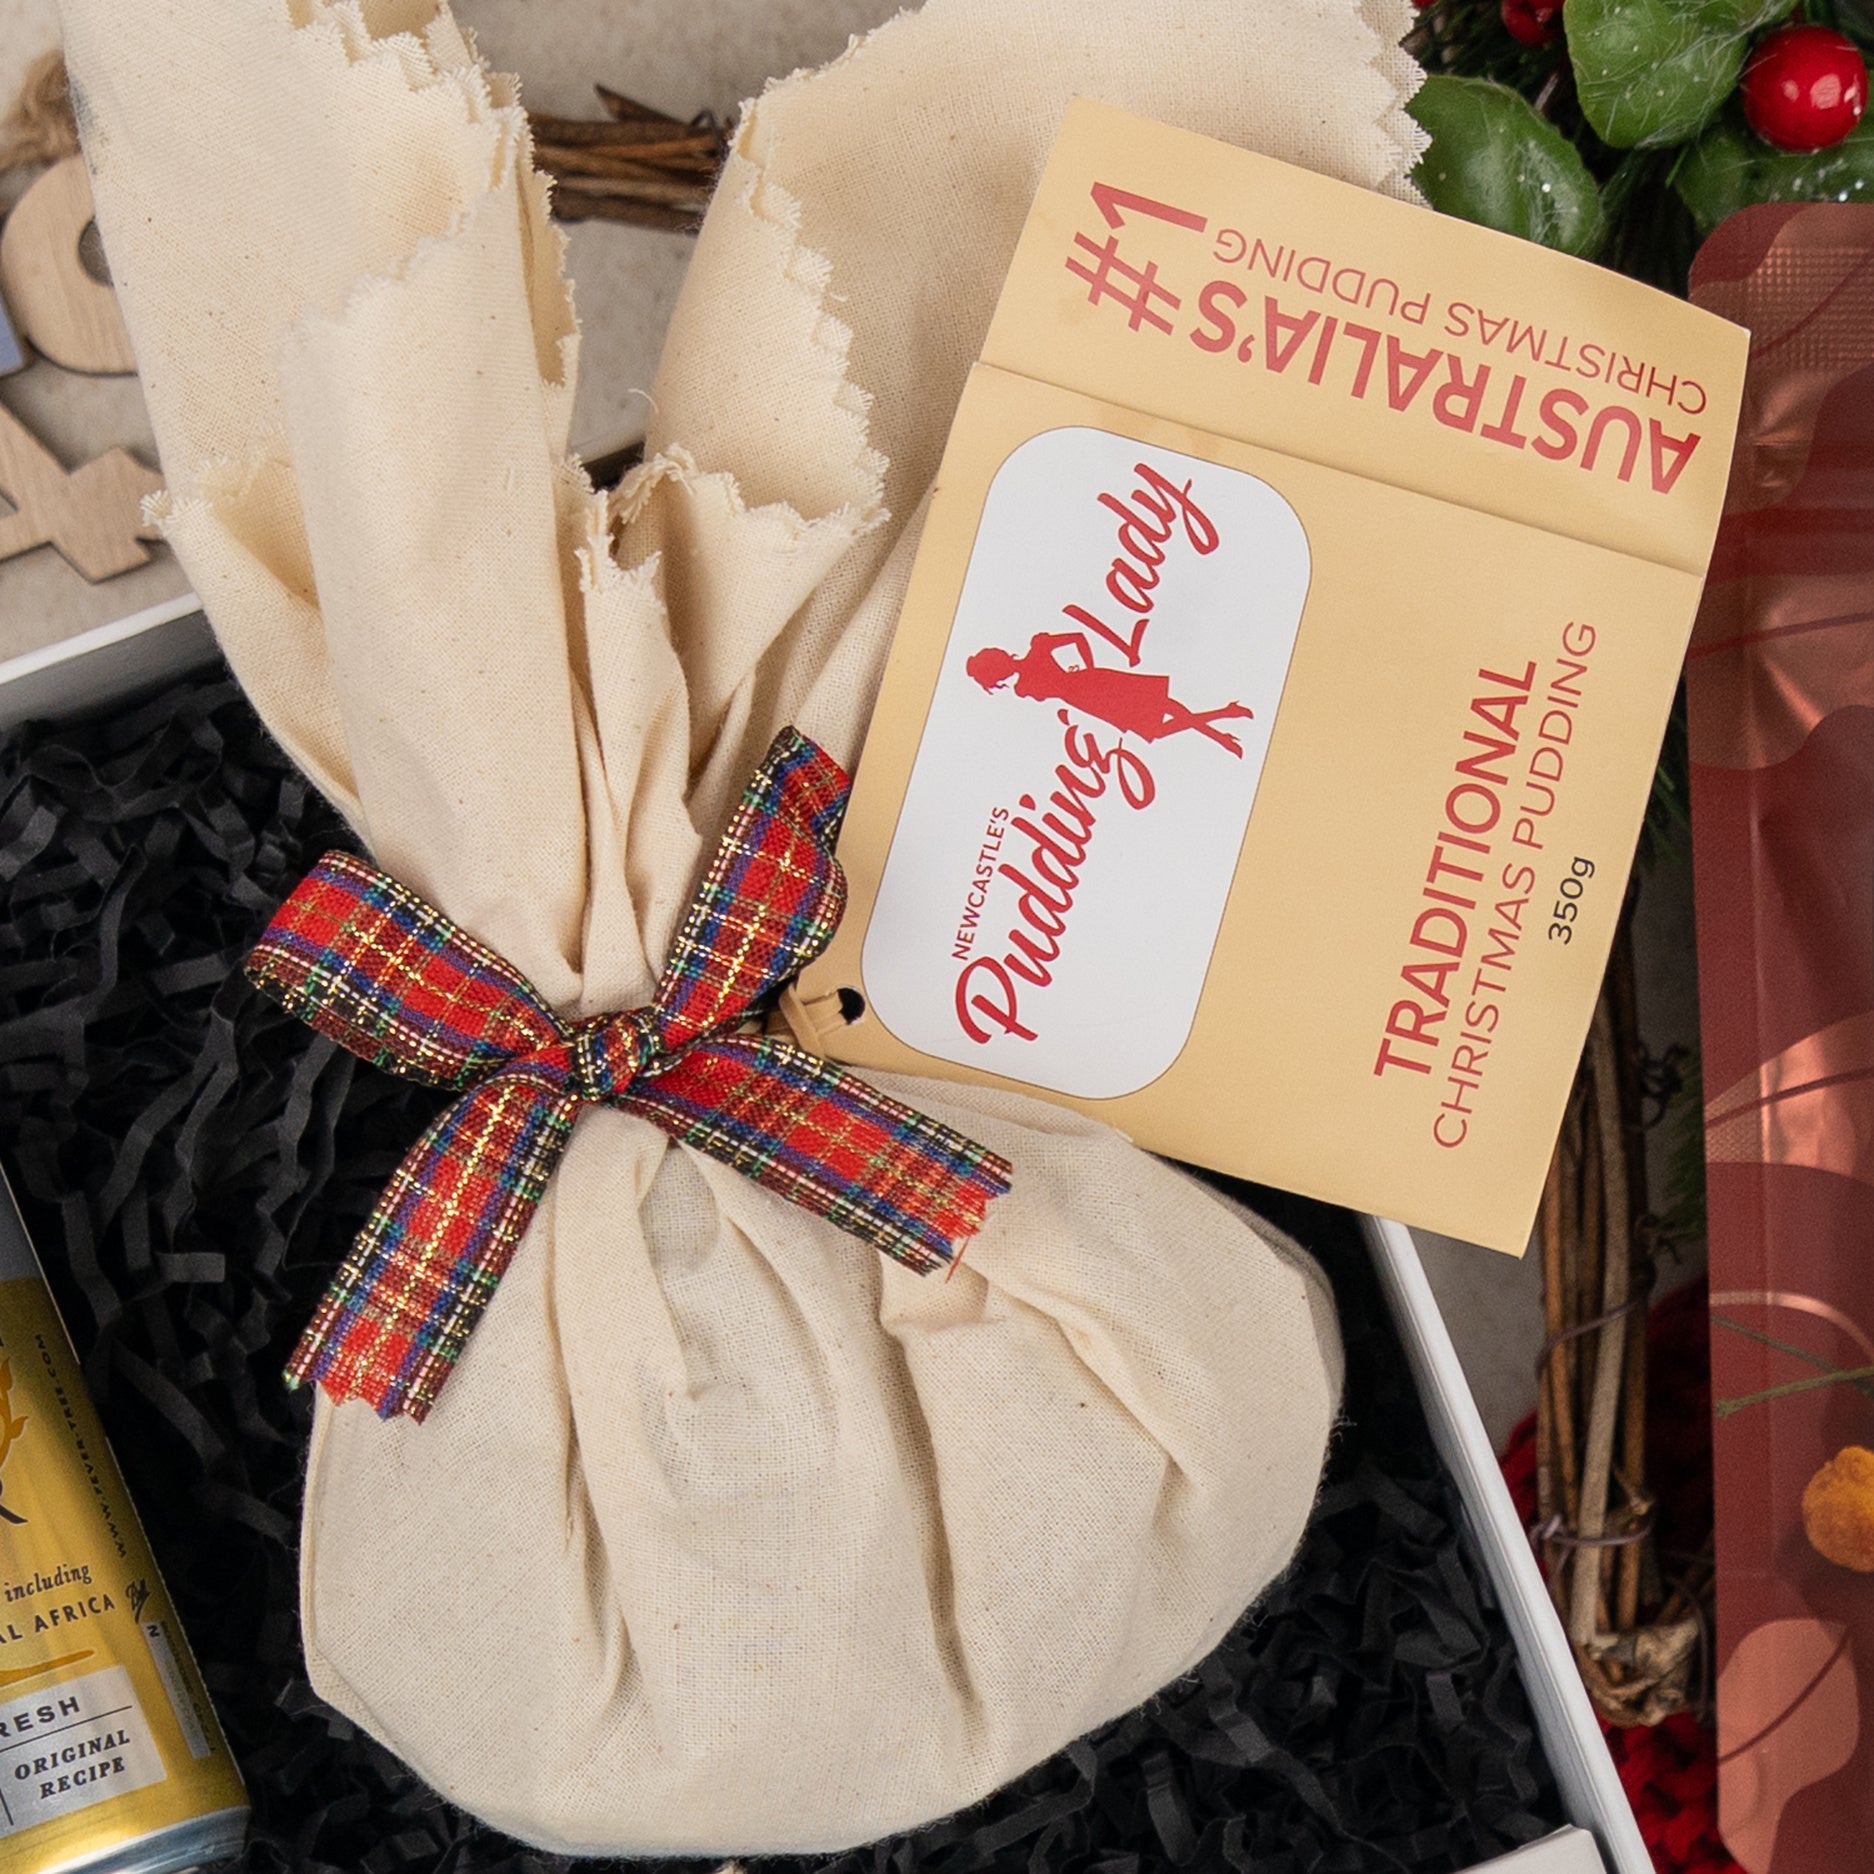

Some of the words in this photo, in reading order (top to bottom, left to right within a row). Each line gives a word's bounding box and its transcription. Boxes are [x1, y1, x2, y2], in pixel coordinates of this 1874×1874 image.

[1065, 182, 1207, 335] #1
[1213, 228, 1432, 325] PUDDING
[1190, 280, 1702, 494] AUSTRALIA'S
[1445, 301, 1708, 416] CHRISTMAS
[955, 709, 1156, 1044] Pudding
[1063, 463, 1220, 667] Lady
[951, 806, 1010, 961] NEWCASTLE'S
[1373, 660, 1537, 1077] TRADITIONAL
[1433, 863, 1537, 1149] CHRISTMAS
[1511, 621, 1597, 850] PUDDING
[1548, 856, 1595, 944] 350g
[4, 1563, 93, 1603] including
[34, 1592, 116, 1634] AFRICA
[15, 1729, 131, 1781] ORIGINAL
[40, 1756, 126, 1800] RECIPE
